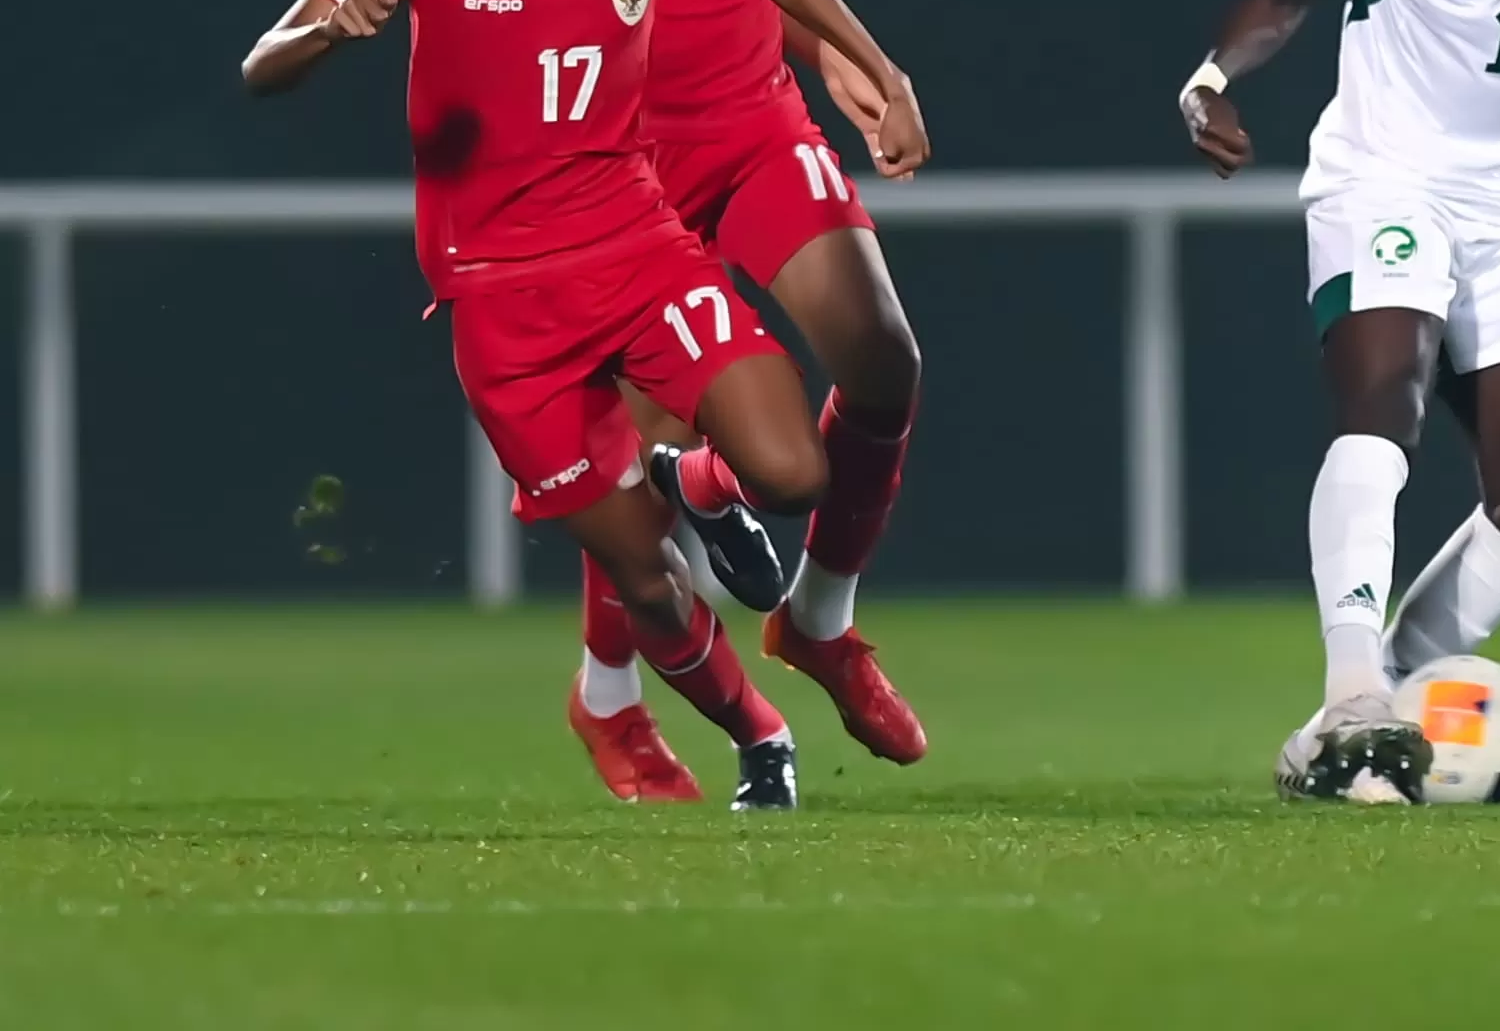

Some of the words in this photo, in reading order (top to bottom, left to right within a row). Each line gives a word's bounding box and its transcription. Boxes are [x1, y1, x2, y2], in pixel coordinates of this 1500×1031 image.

[538, 46, 602, 123] 17
[664, 286, 732, 361] 17
[540, 457, 590, 490] erspo
